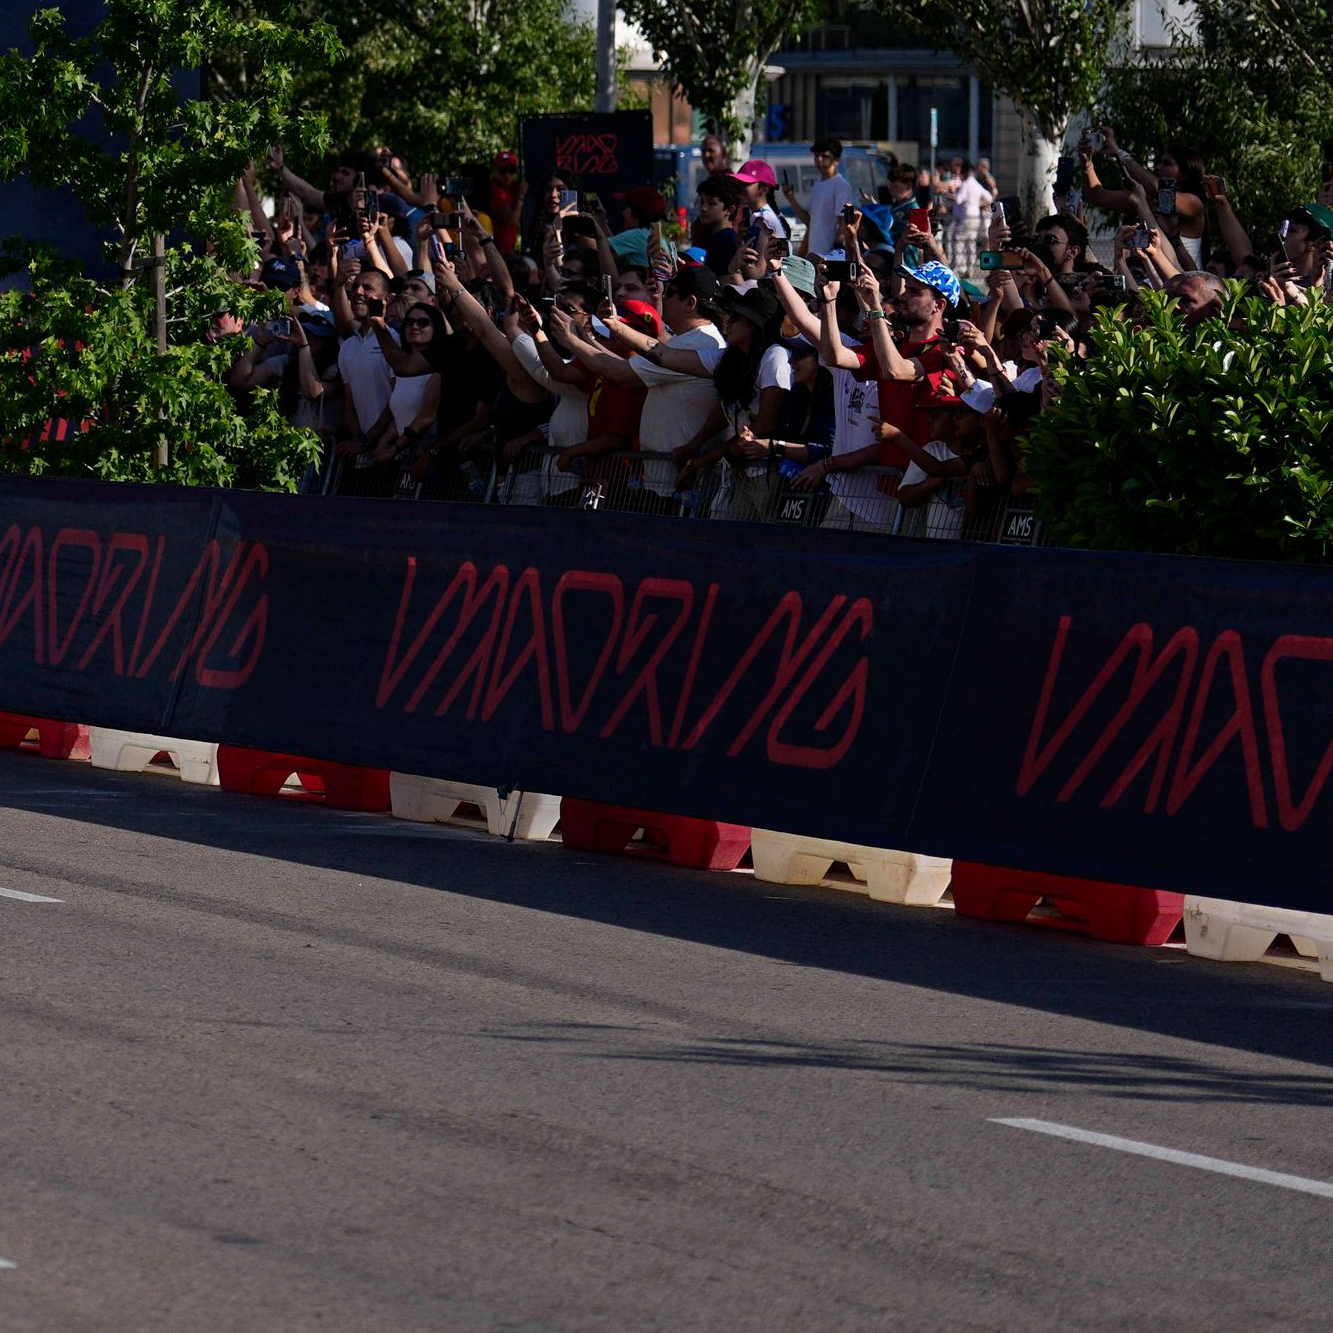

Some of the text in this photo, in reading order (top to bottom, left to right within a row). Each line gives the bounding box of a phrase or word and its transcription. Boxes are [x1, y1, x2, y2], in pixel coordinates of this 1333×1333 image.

[780, 498, 803, 520] AMS
[1007, 515, 1033, 537] AMS
[375, 555, 874, 770] MADRING
